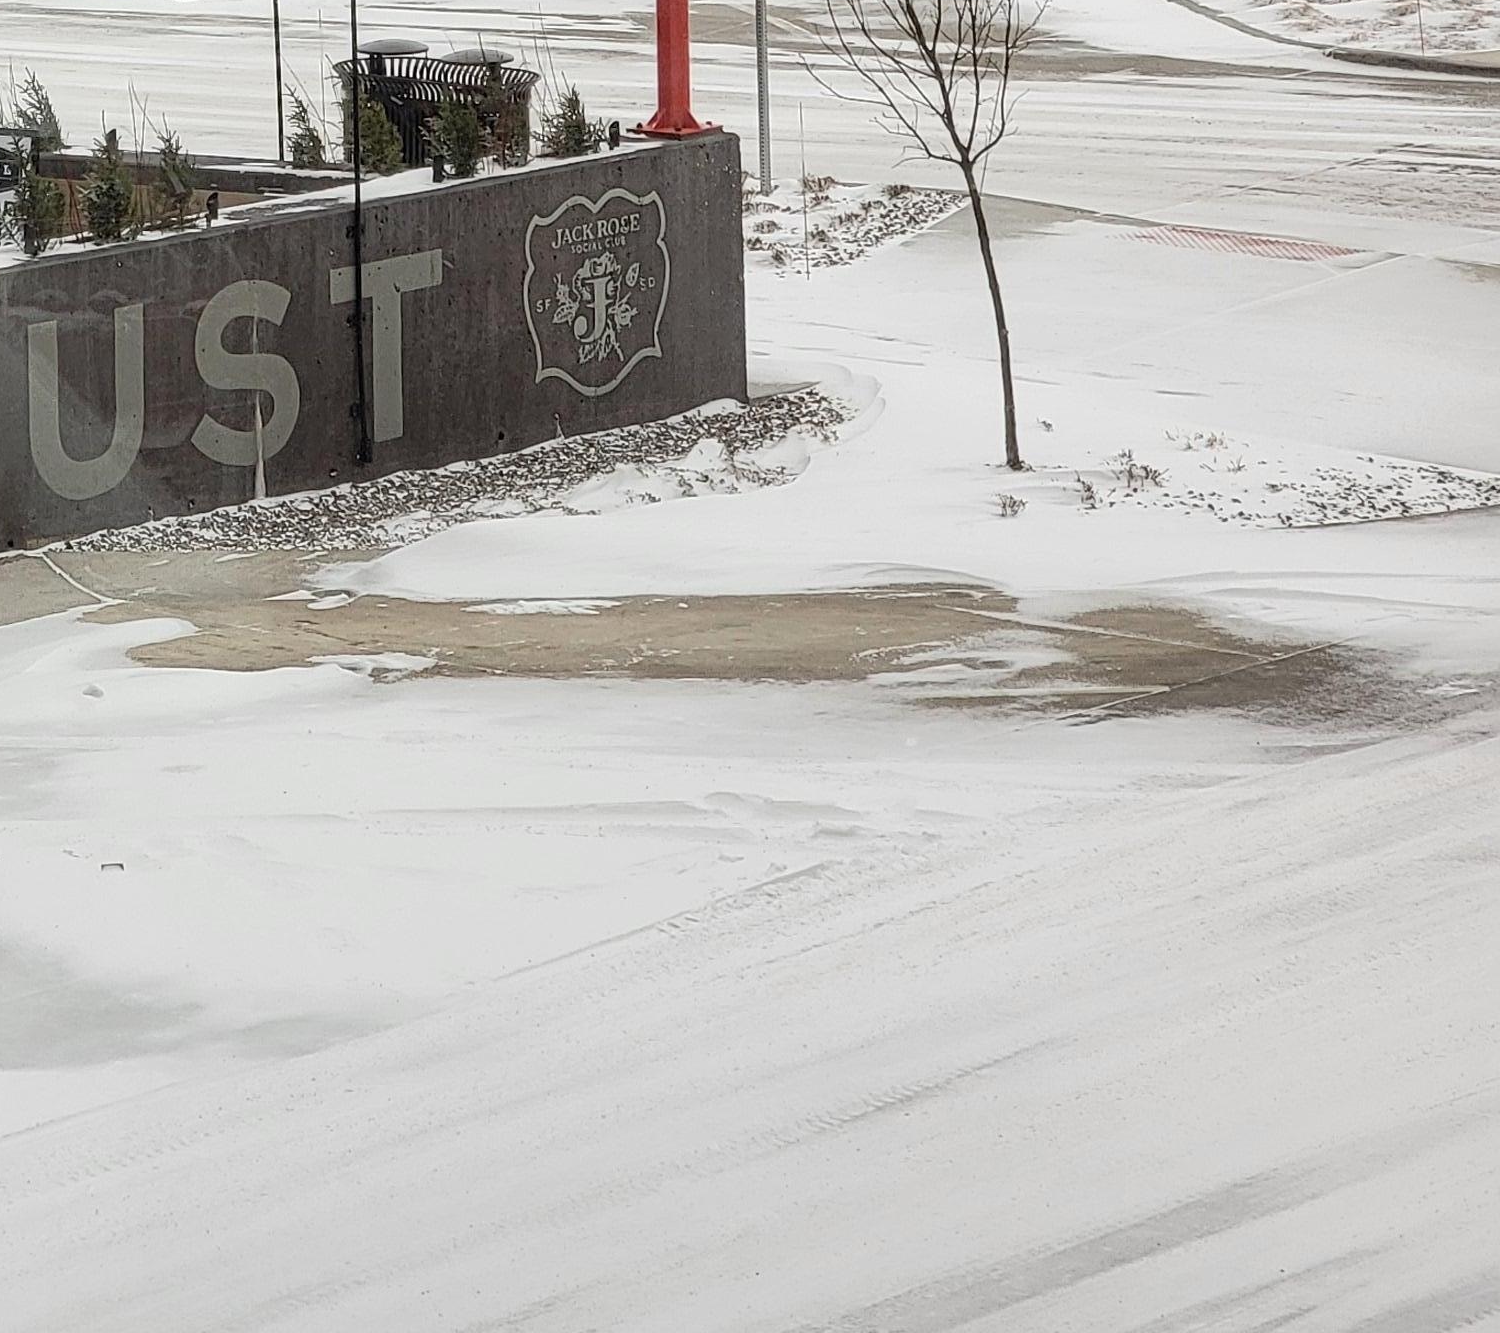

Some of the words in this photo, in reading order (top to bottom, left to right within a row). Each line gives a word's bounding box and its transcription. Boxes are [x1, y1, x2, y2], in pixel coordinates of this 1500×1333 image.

[552, 222, 595, 249] JACK
[597, 213, 641, 237] ROSE
[571, 241, 602, 254] SOCIAL
[604, 236, 626, 249] CLUB
[536, 298, 551, 313] SF
